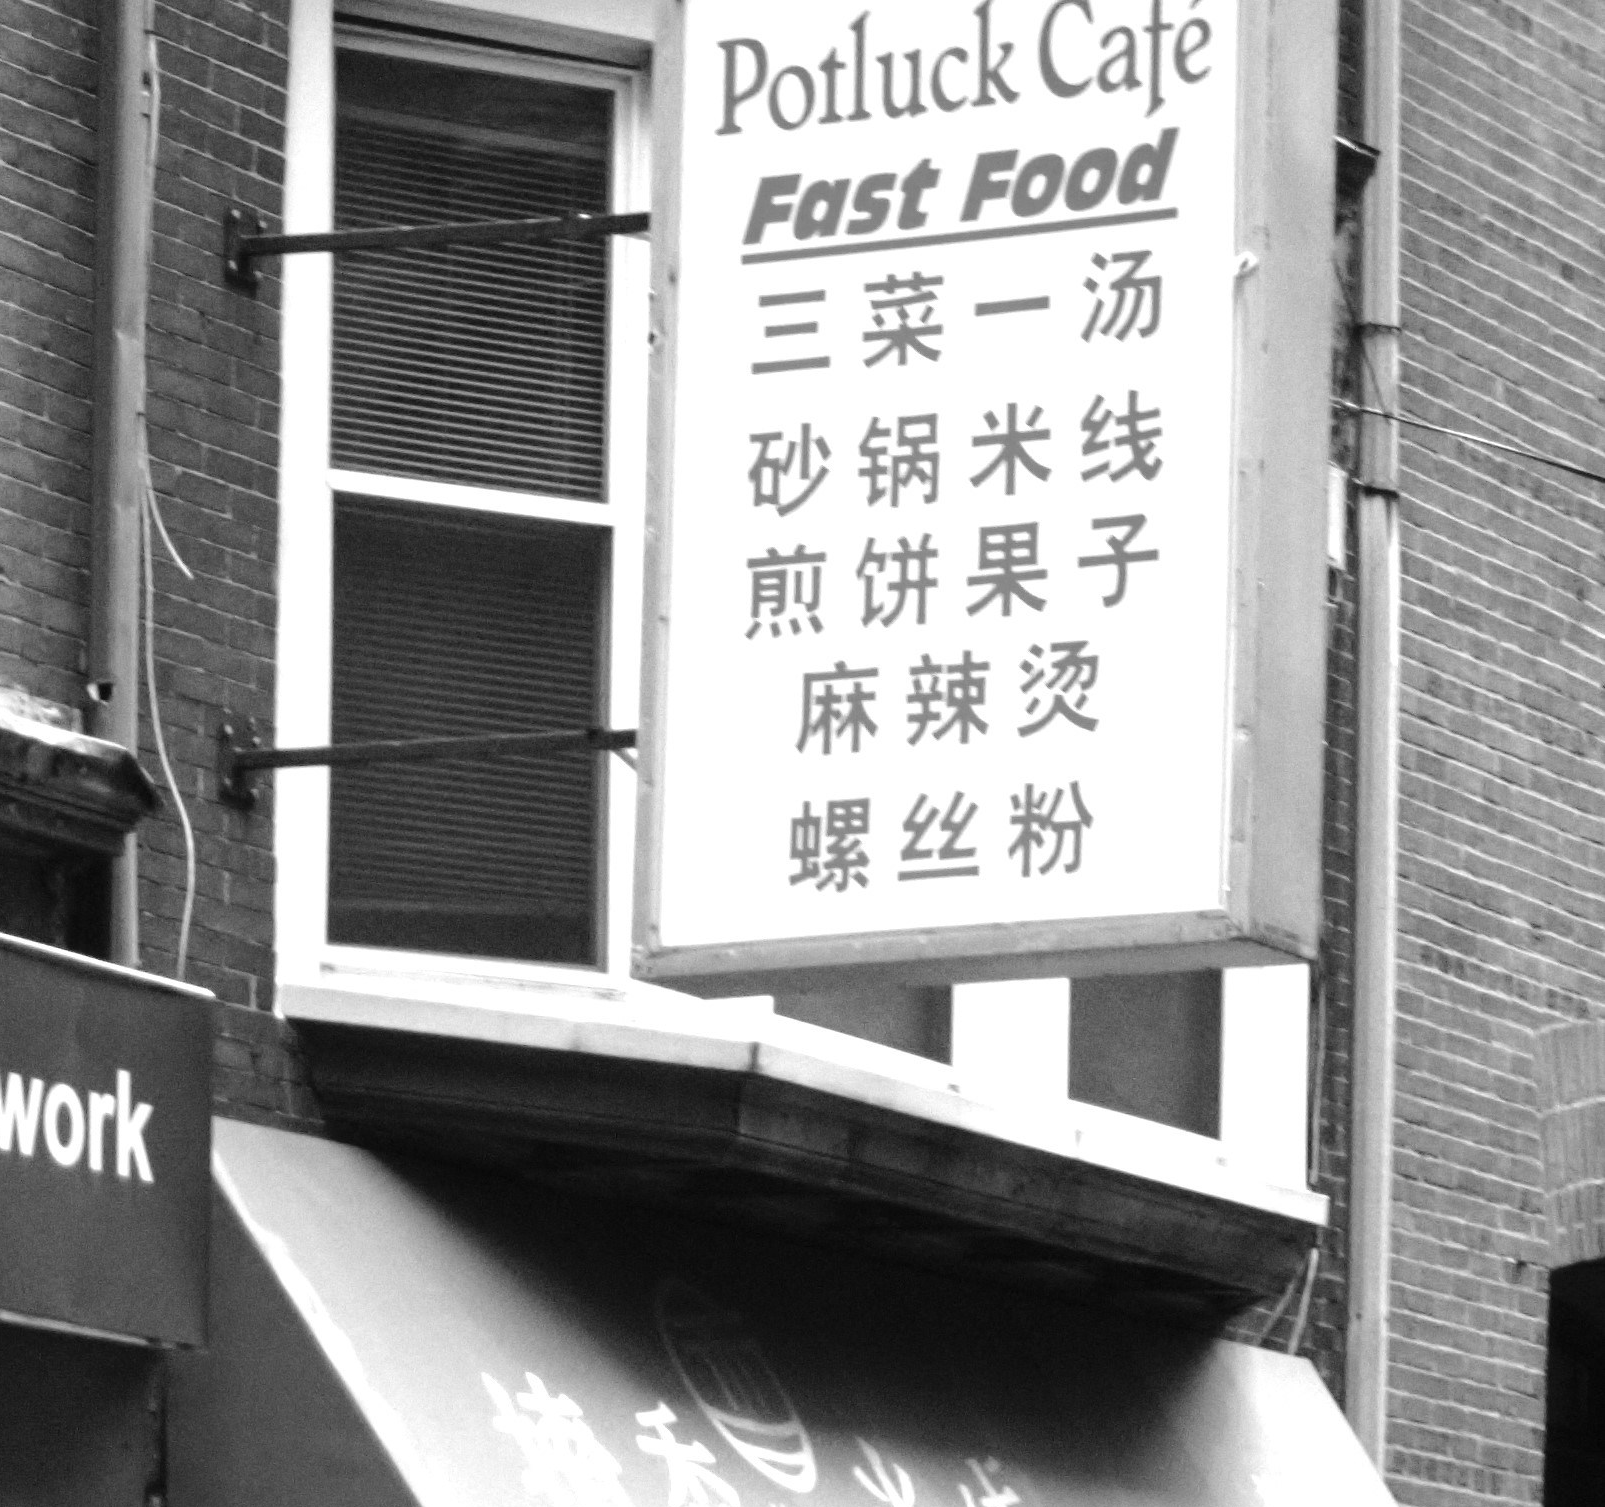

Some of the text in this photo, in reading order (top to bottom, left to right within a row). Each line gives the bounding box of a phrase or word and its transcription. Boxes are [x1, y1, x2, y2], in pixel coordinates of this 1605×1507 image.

[715, 0, 1214, 136] Potluck Café
[742, 126, 1180, 246] Fast Food
[750, 249, 1164, 375] 三菜一汤
[747, 389, 1166, 518] 砂锅米线
[744, 512, 1160, 641] 煎饼果子
[794, 639, 1102, 757] 麻辣烫
[787, 779, 1095, 894] 螺丝粉
